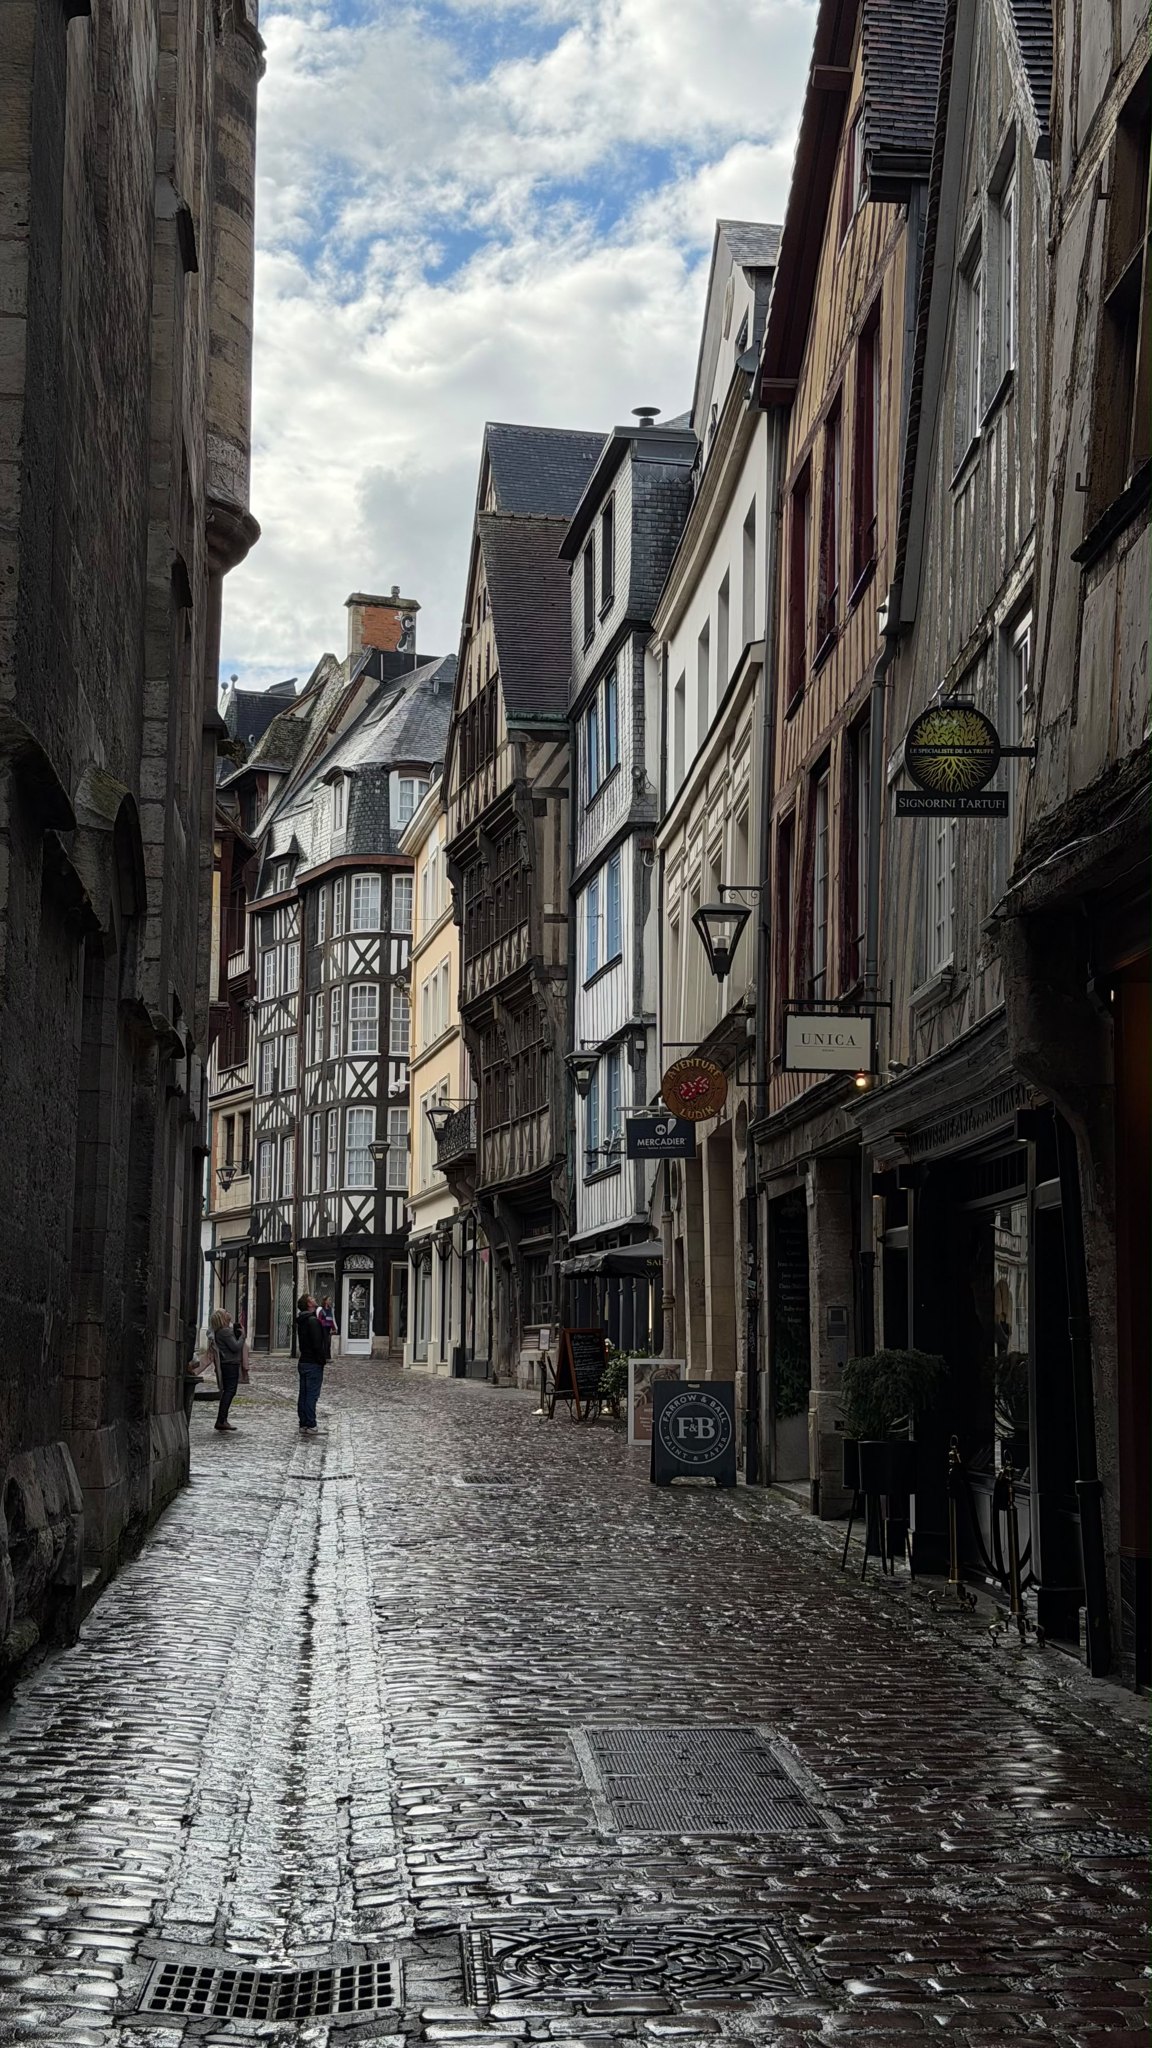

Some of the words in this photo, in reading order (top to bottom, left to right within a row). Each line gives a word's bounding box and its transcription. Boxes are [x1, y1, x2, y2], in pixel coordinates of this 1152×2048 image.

[899, 797, 956, 808] SIGNORINI
[958, 798, 1006, 809] TARTUFI
[801, 1033, 856, 1046] UNICA
[667, 1058, 722, 1081] AVENTURE
[637, 1137, 685, 1147] MERCADIER
[662, 1394, 697, 1422] FARROW
[709, 1401, 728, 1424] BALL
[676, 1417, 716, 1439] F&B
[664, 1435, 689, 1459] PAINT
[704, 1437, 728, 1460] PAPER
